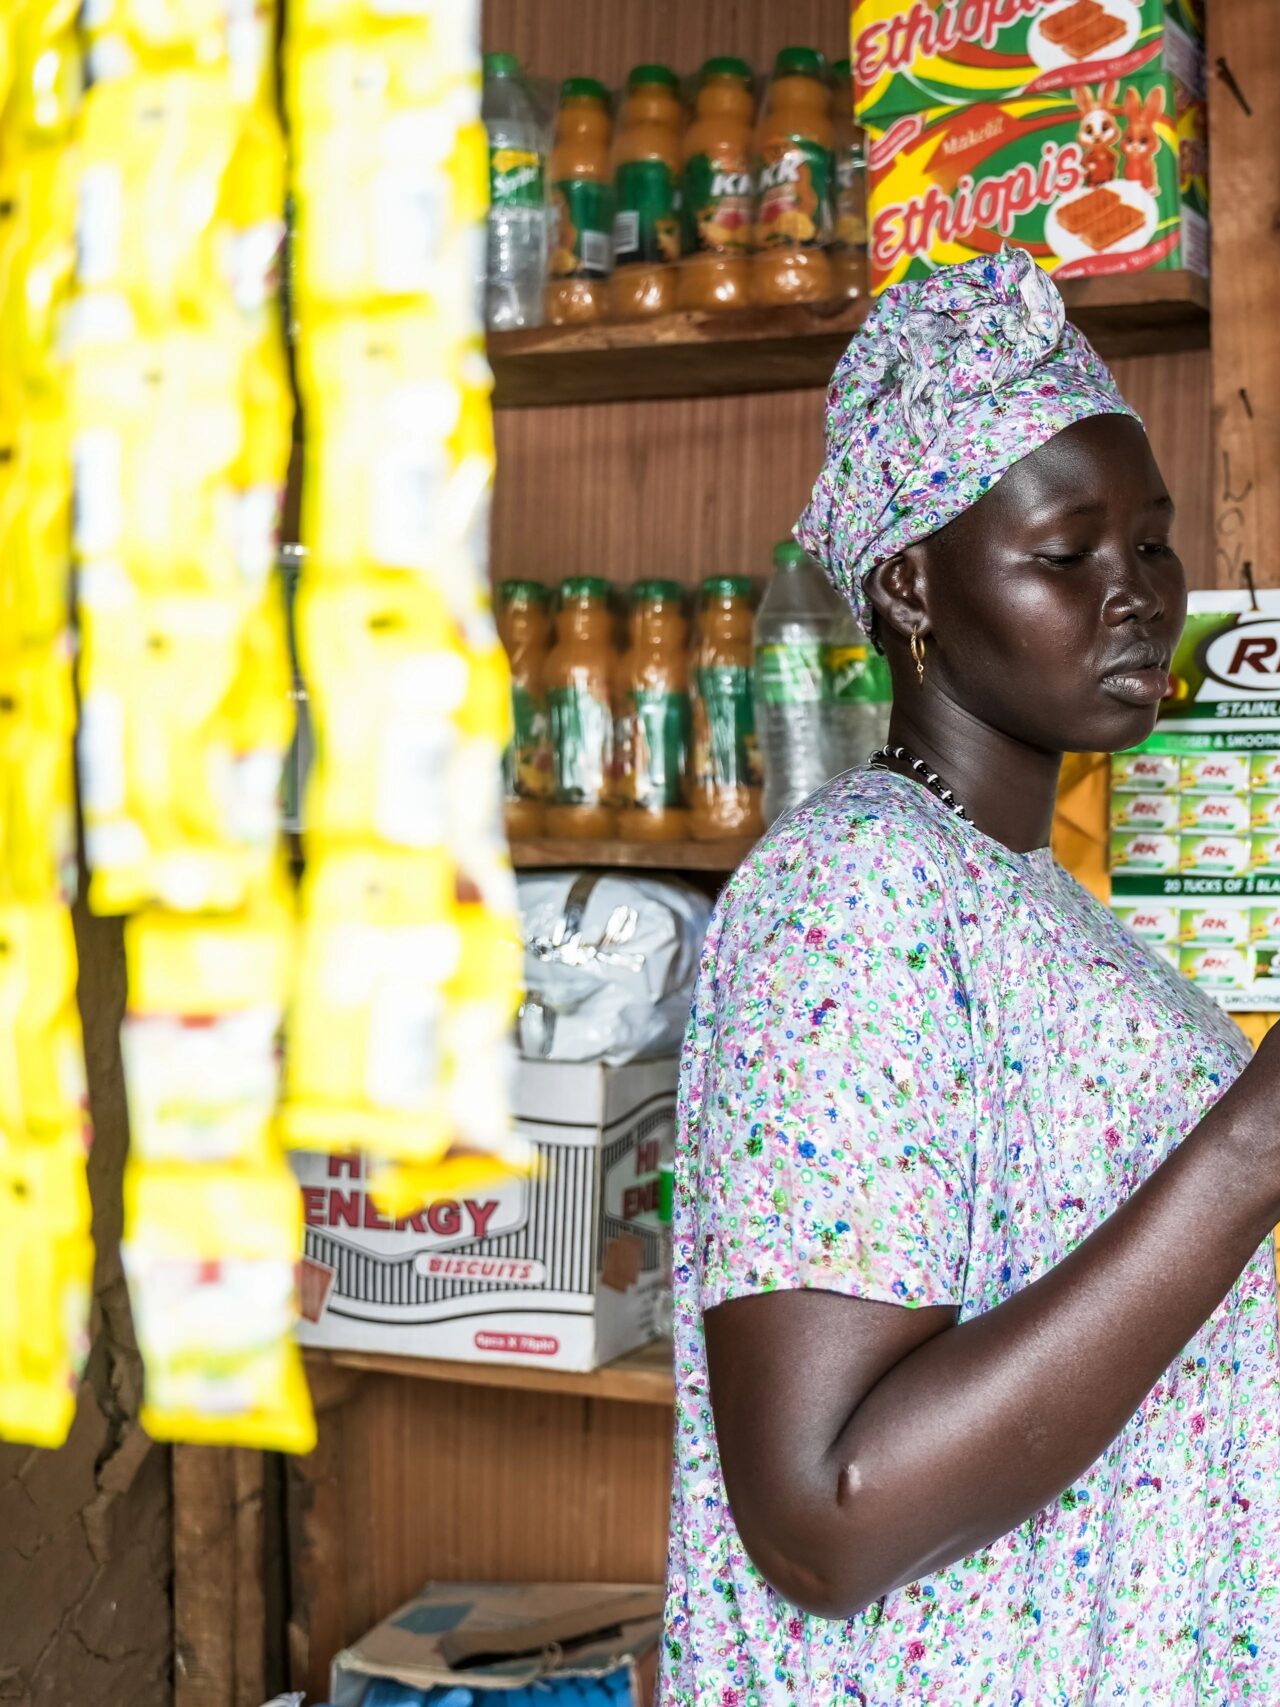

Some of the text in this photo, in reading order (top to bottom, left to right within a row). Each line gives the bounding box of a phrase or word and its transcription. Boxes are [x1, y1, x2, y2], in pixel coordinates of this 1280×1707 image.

[854, 0, 1055, 86] Ethiop
[873, 141, 1085, 269] Ethiopis
[1201, 765, 1229, 777] RK
[1202, 804, 1229, 817] RK
[1202, 845, 1229, 857] RK
[1164, 878, 1180, 893] 20
[1182, 878, 1222, 893] TUCKS
[1224, 879, 1243, 893] OF
[1132, 916, 1158, 927] RK
[1201, 917, 1227, 929] RK
[636, 1139, 659, 1178] HI
[428, 1255, 534, 1281] BISCUITS
